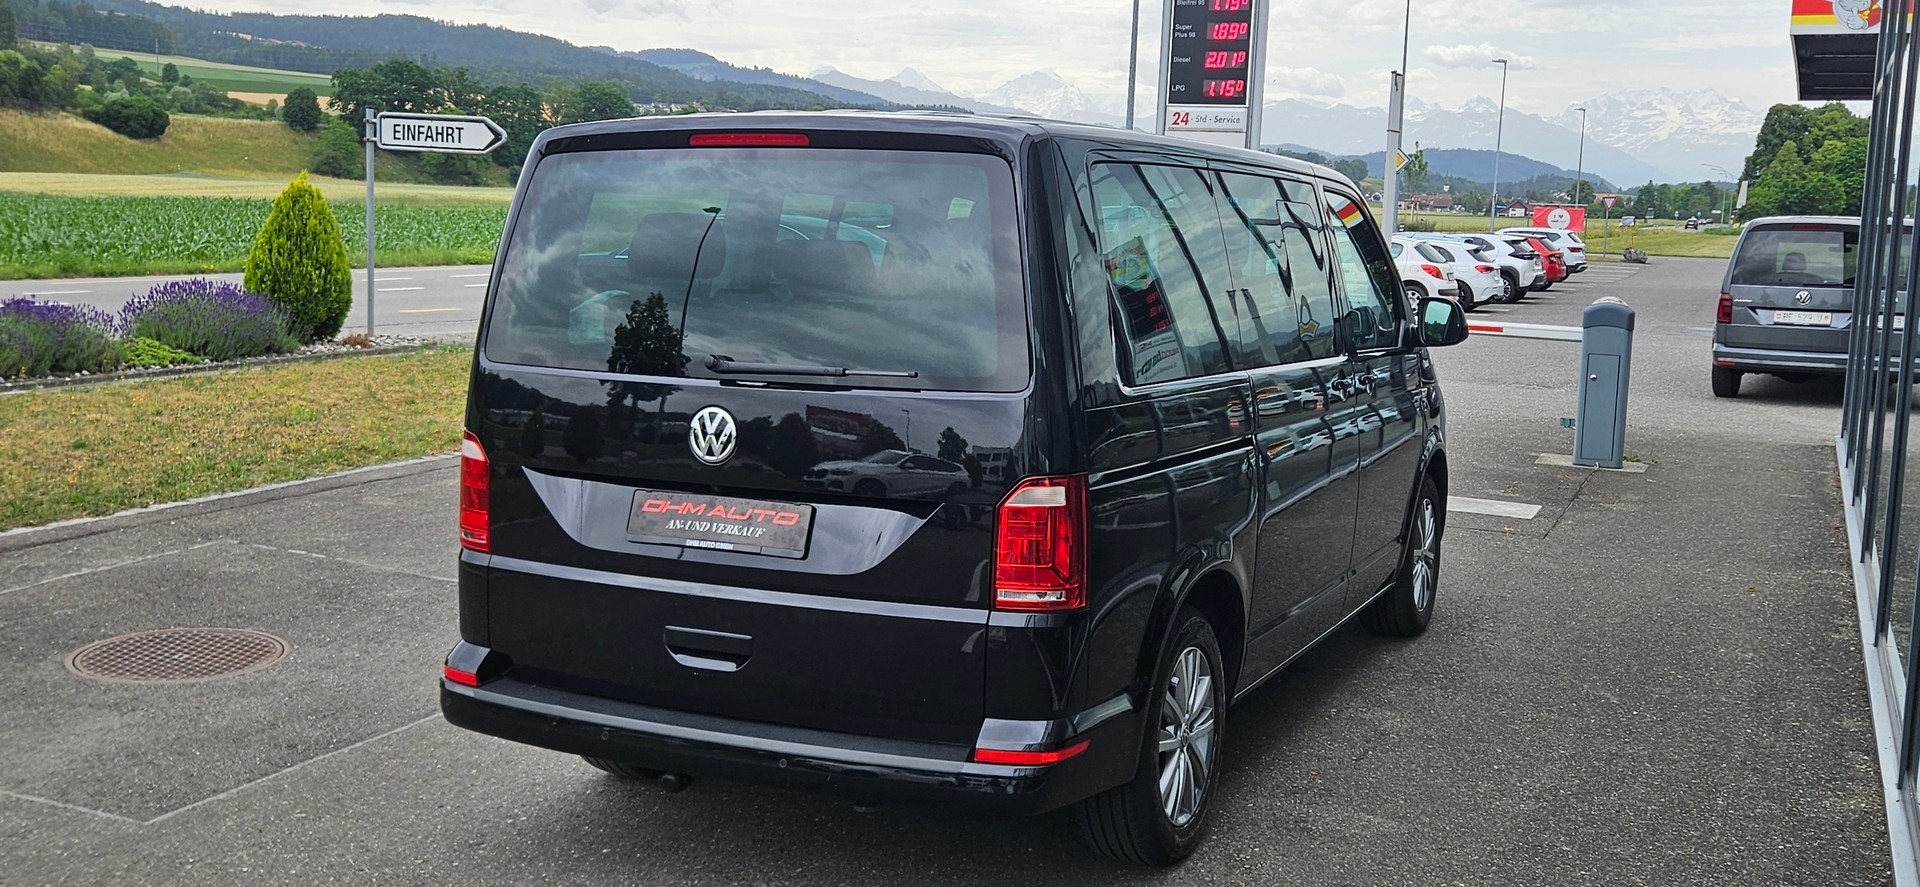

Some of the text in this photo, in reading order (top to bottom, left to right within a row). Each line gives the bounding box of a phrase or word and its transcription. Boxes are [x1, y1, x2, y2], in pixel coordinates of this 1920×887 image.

[1171, 111, 1190, 126] 24
[393, 123, 464, 144] EINFAHRT
[641, 499, 800, 526] OHM AUTO
[684, 520, 711, 532] UND
[710, 522, 766, 538] VERKAUF
